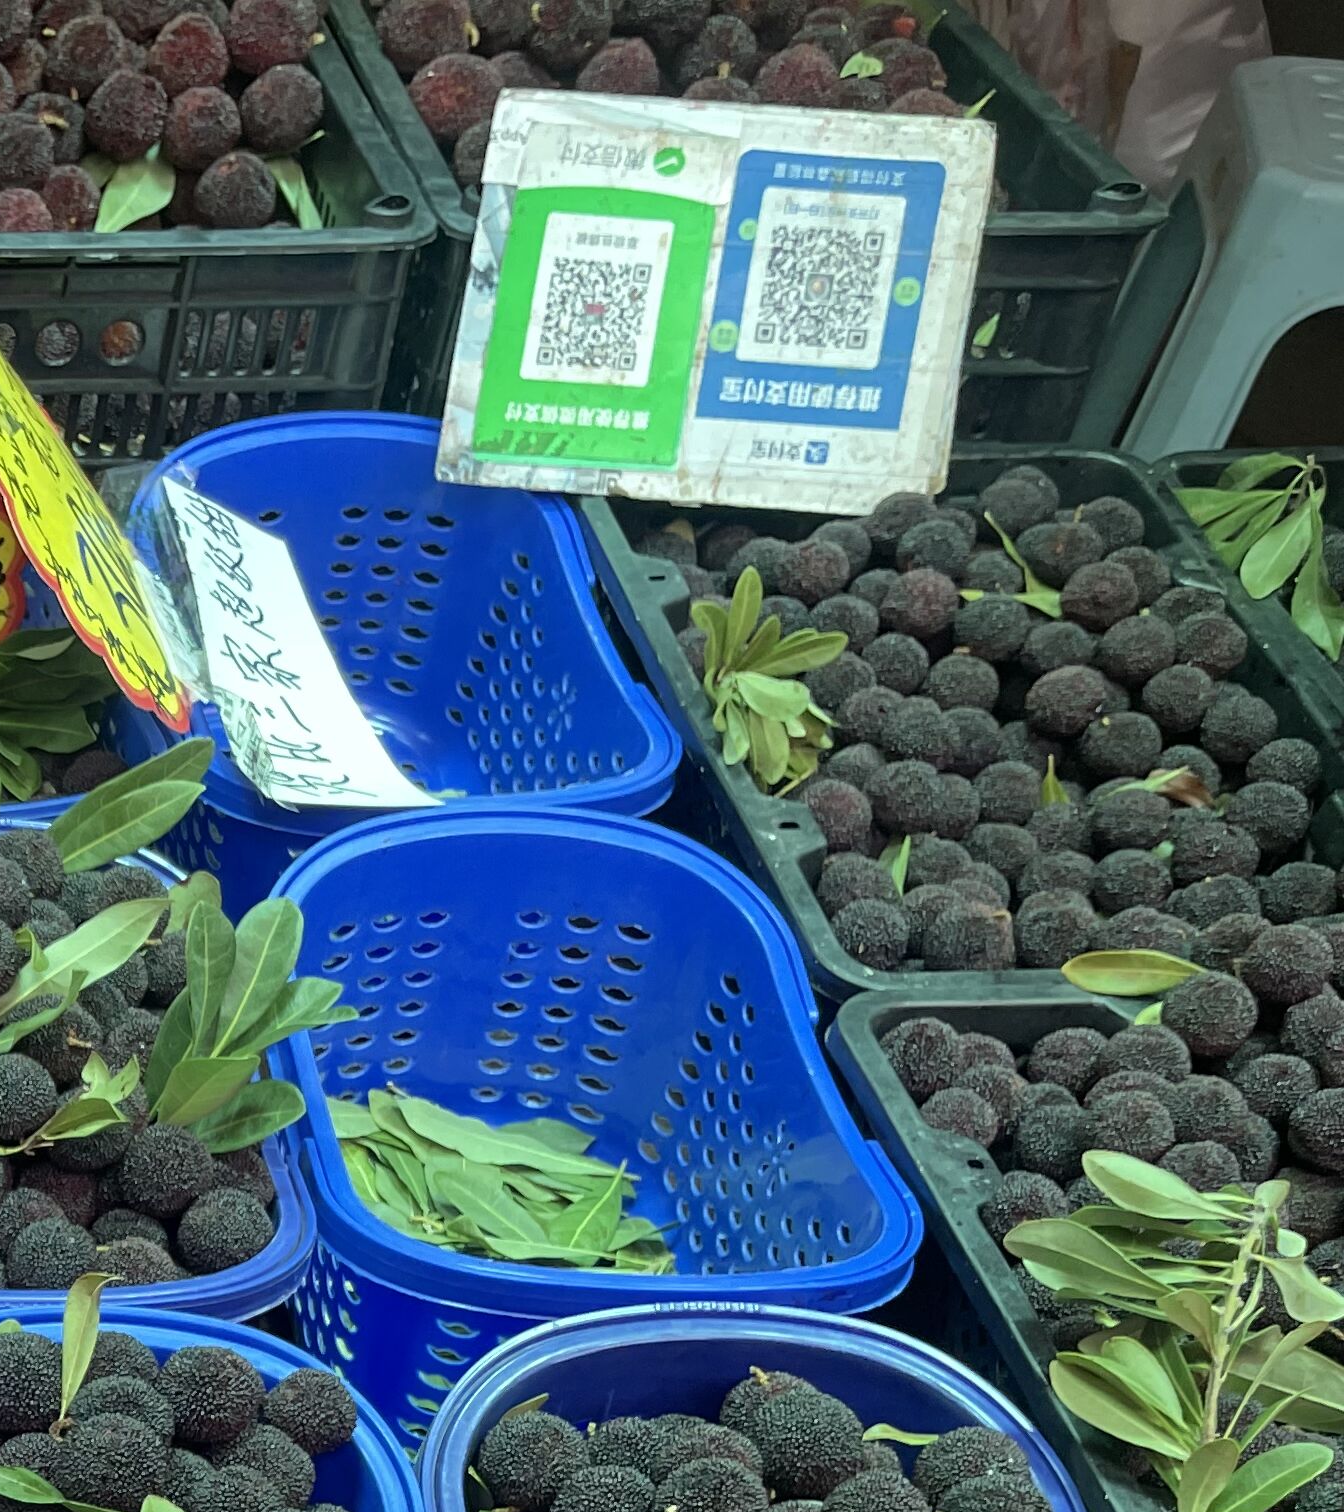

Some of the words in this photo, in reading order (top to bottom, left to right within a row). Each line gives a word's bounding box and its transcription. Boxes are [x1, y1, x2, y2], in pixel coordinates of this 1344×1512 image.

[559, 141, 647, 174] 微信支付
[719, 376, 883, 413] 推荐使用支付宝
[504, 401, 650, 431] 推荐使用微信支付
[751, 438, 803, 463] 支付宝
